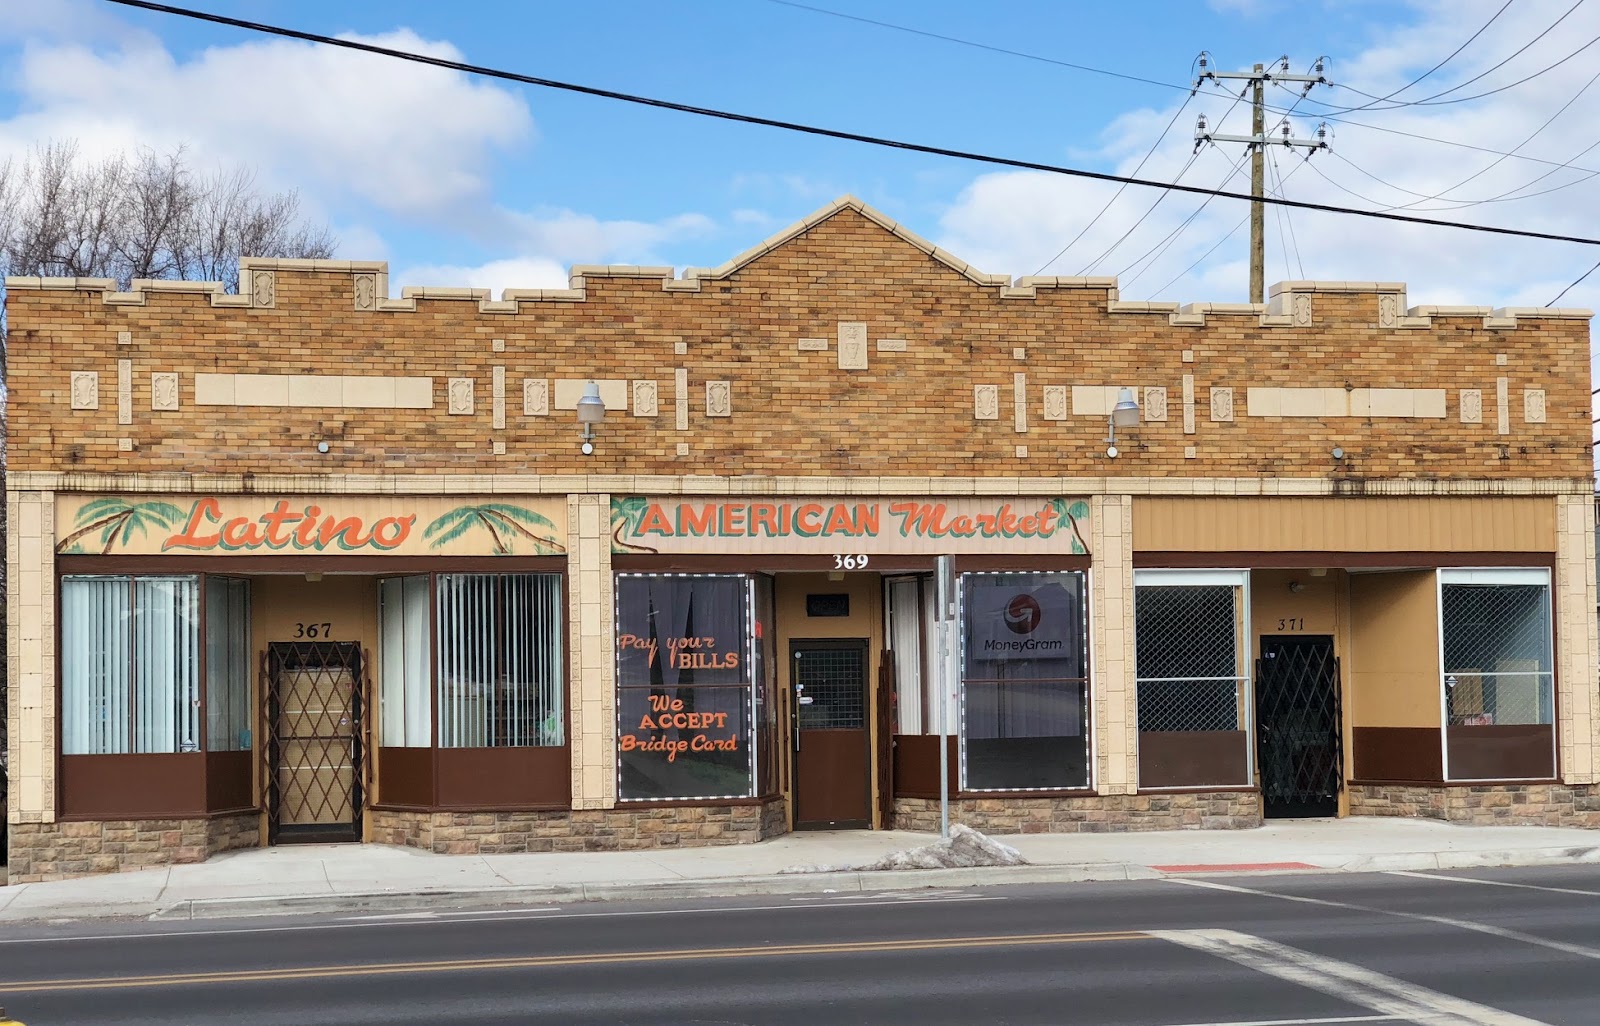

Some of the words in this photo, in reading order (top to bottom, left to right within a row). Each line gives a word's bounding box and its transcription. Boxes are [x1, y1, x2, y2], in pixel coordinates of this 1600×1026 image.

[161, 497, 417, 551] Latino
[632, 503, 879, 537] AMERICAN
[889, 500, 1059, 539] Market
[833, 554, 869, 569] 369
[293, 622, 331, 638] 367
[1277, 617, 1304, 631] 371
[620, 633, 658, 669] Pay
[666, 636, 715, 669] your
[984, 639, 1062, 652] MoneyGram
[678, 652, 739, 669] BILLS
[647, 694, 684, 712] We
[638, 712, 728, 729] ACCEPT
[620, 734, 688, 762] Bridge
[691, 733, 738, 751] Card
